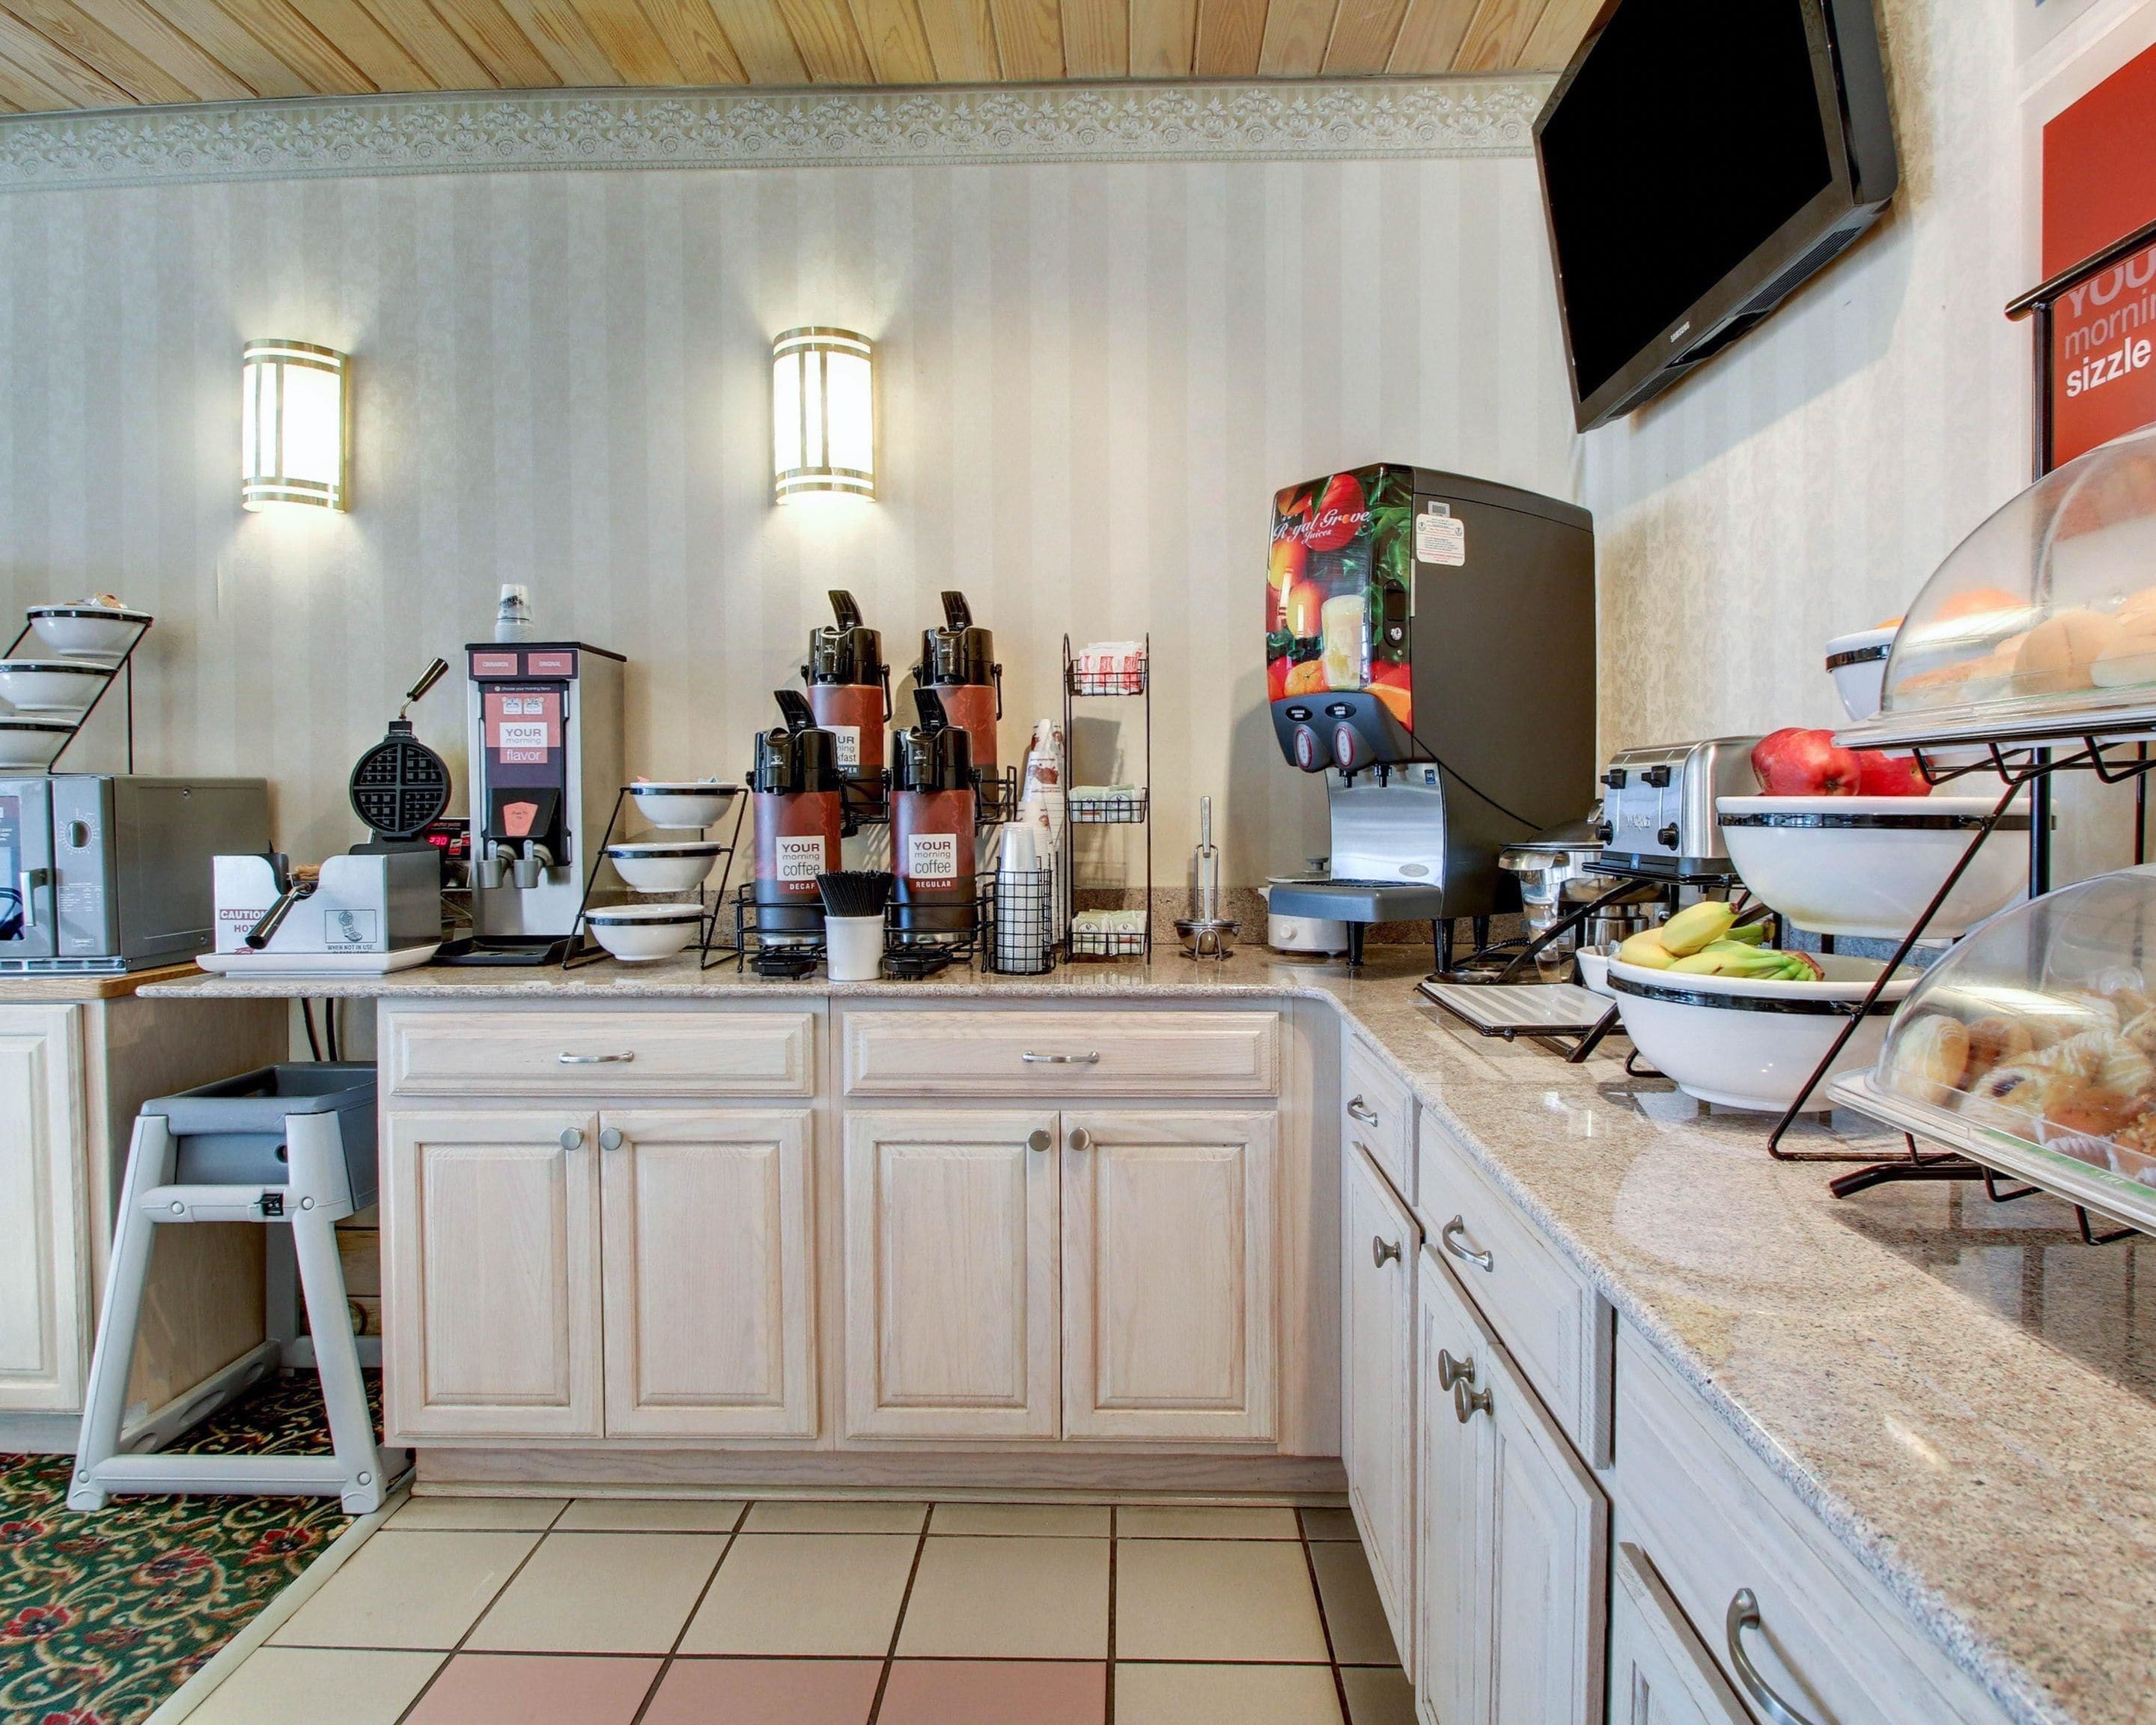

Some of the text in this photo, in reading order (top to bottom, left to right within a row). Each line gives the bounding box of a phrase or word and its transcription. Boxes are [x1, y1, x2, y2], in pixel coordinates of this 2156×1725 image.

[1670, 321, 1690, 343] SAMSUNG
[2066, 337, 2151, 398] sizzle
[506, 728, 541, 737] YOUR
[507, 749, 540, 761] flavor
[782, 844, 820, 852] YOUR
[914, 842, 951, 851] YOUR
[915, 851, 951, 859] morning
[783, 862, 820, 876] coffee
[915, 860, 951, 874] coffee
